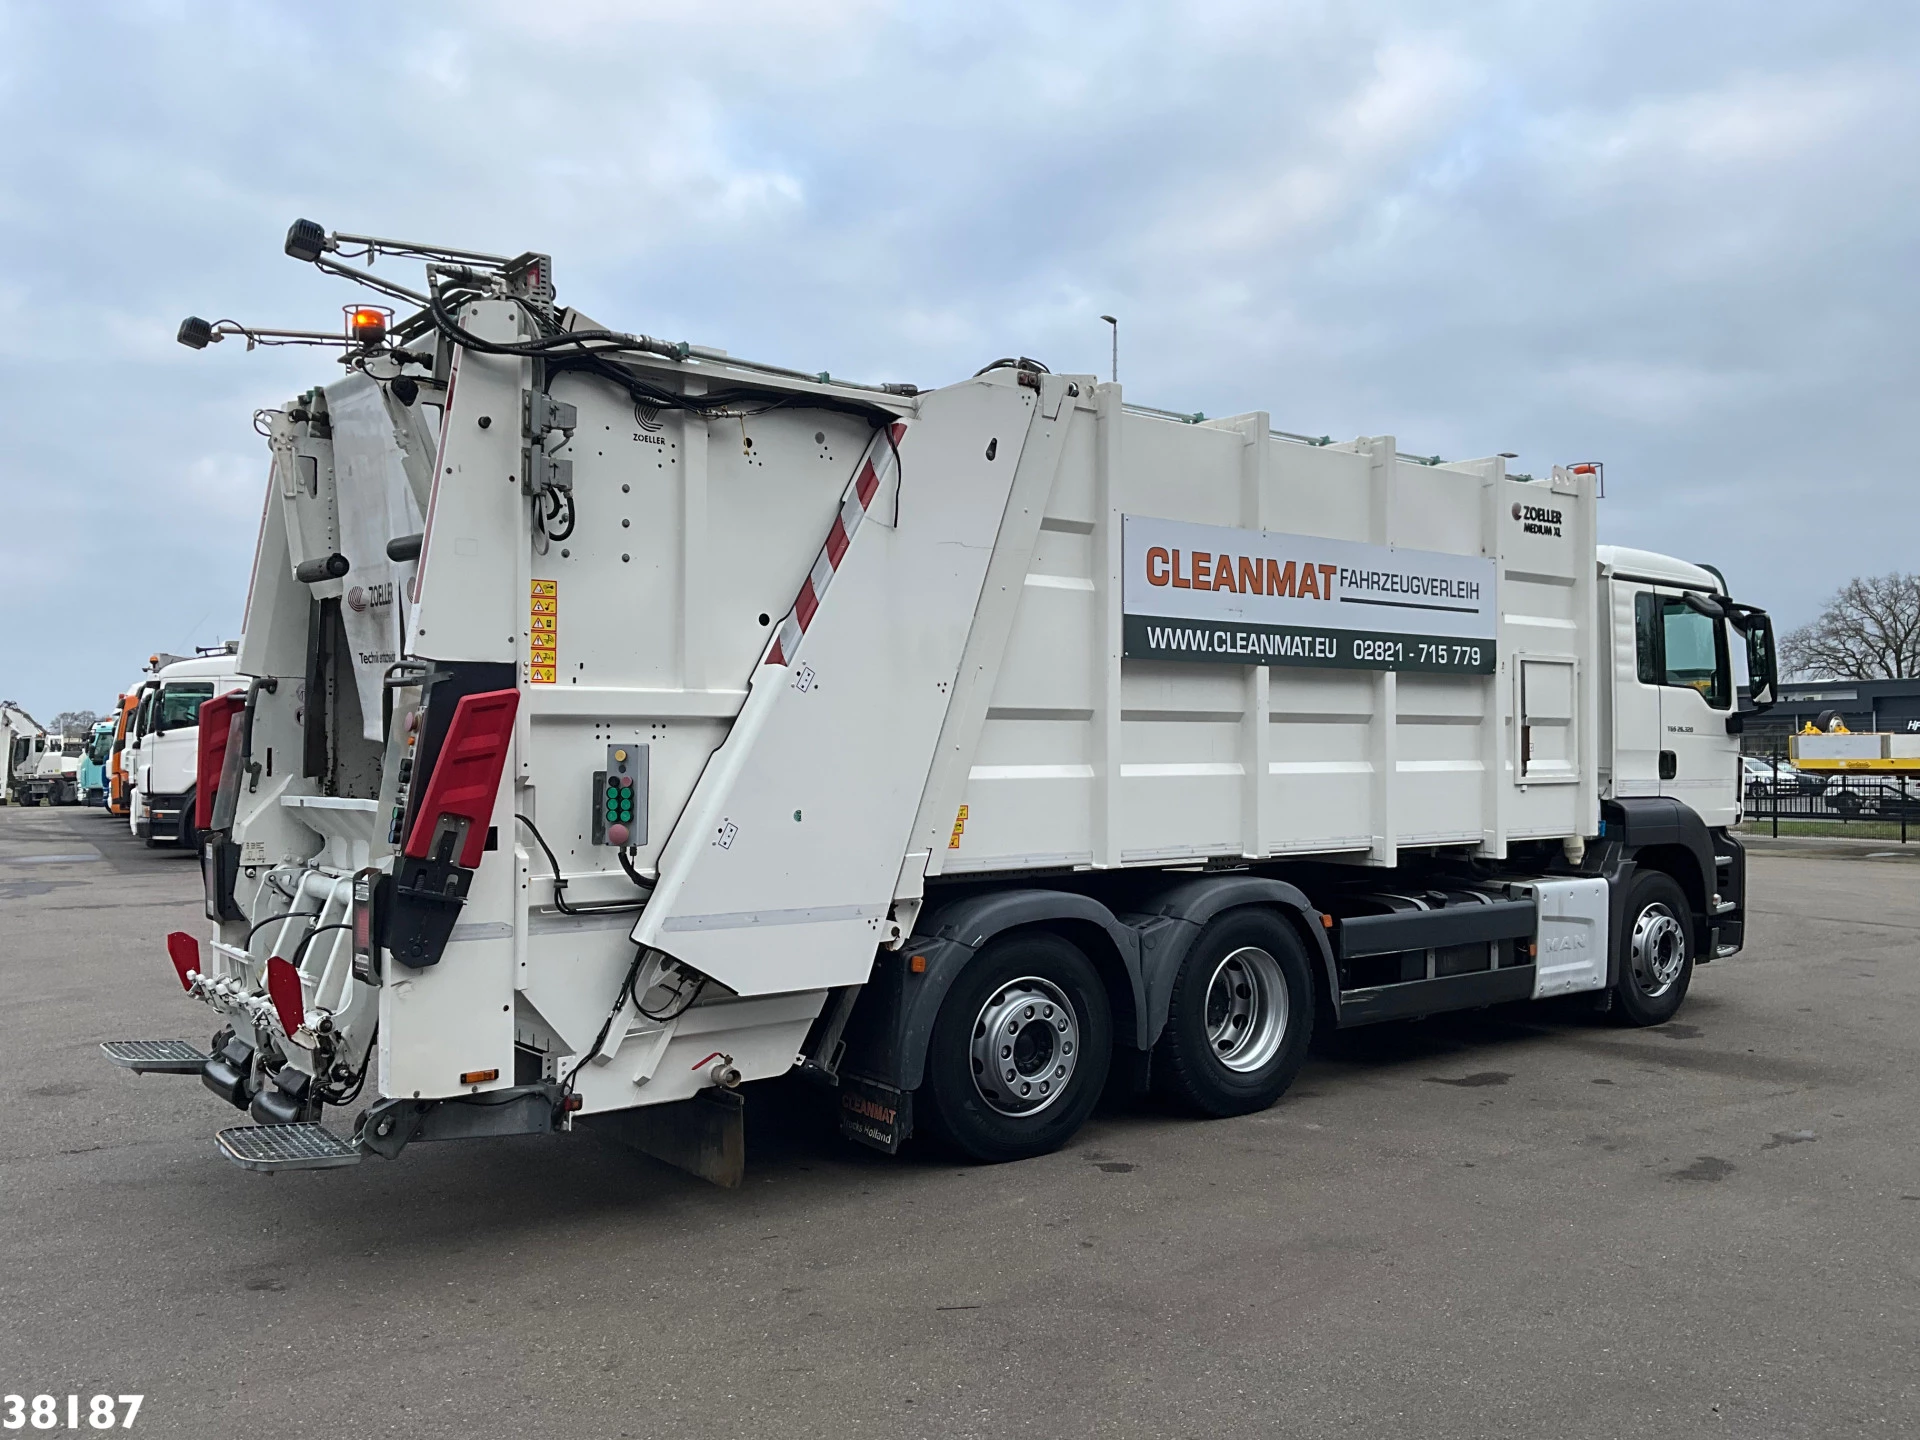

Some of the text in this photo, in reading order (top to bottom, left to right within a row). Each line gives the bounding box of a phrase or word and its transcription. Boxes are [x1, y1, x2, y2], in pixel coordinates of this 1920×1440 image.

[633, 433, 665, 446] ZOELLER
[1523, 505, 1562, 525] ZOELLER
[1523, 522, 1562, 538] MEDIUM XL
[1146, 546, 1480, 601] CLEANMAT FAHRZEUGVERLEIH
[1147, 626, 1337, 659] WWW.CLEANMAT.EU
[1353, 639, 1405, 663] 02821
[1418, 643, 1448, 665] 715
[1452, 645, 1481, 666] 779
[1544, 933, 1586, 953] MAN
[841, 1094, 897, 1125] CLEANMAT
[863, 1125, 892, 1144] Holland
